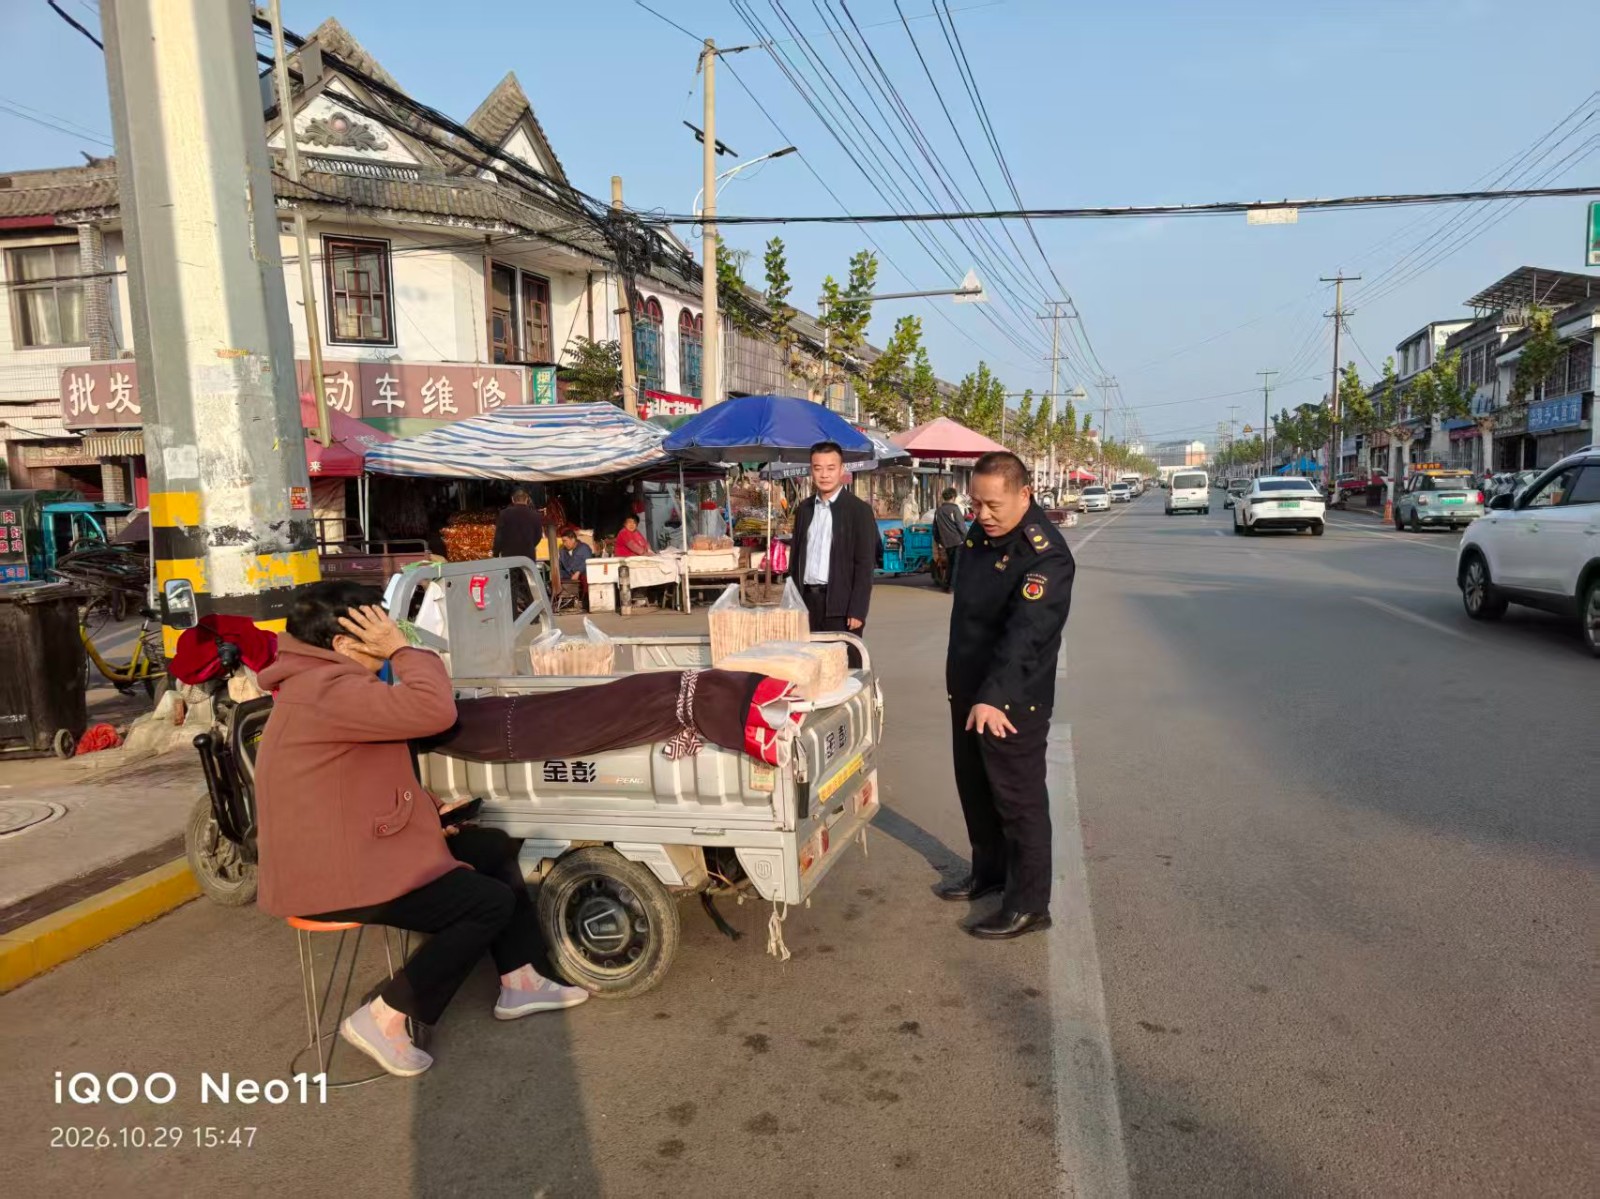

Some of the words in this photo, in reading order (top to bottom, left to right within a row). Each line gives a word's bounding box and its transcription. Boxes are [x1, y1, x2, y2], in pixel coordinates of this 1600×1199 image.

[68, 371, 142, 417] 批发
[323, 370, 507, 414] 动车维修
[543, 760, 598, 783] 金彭
